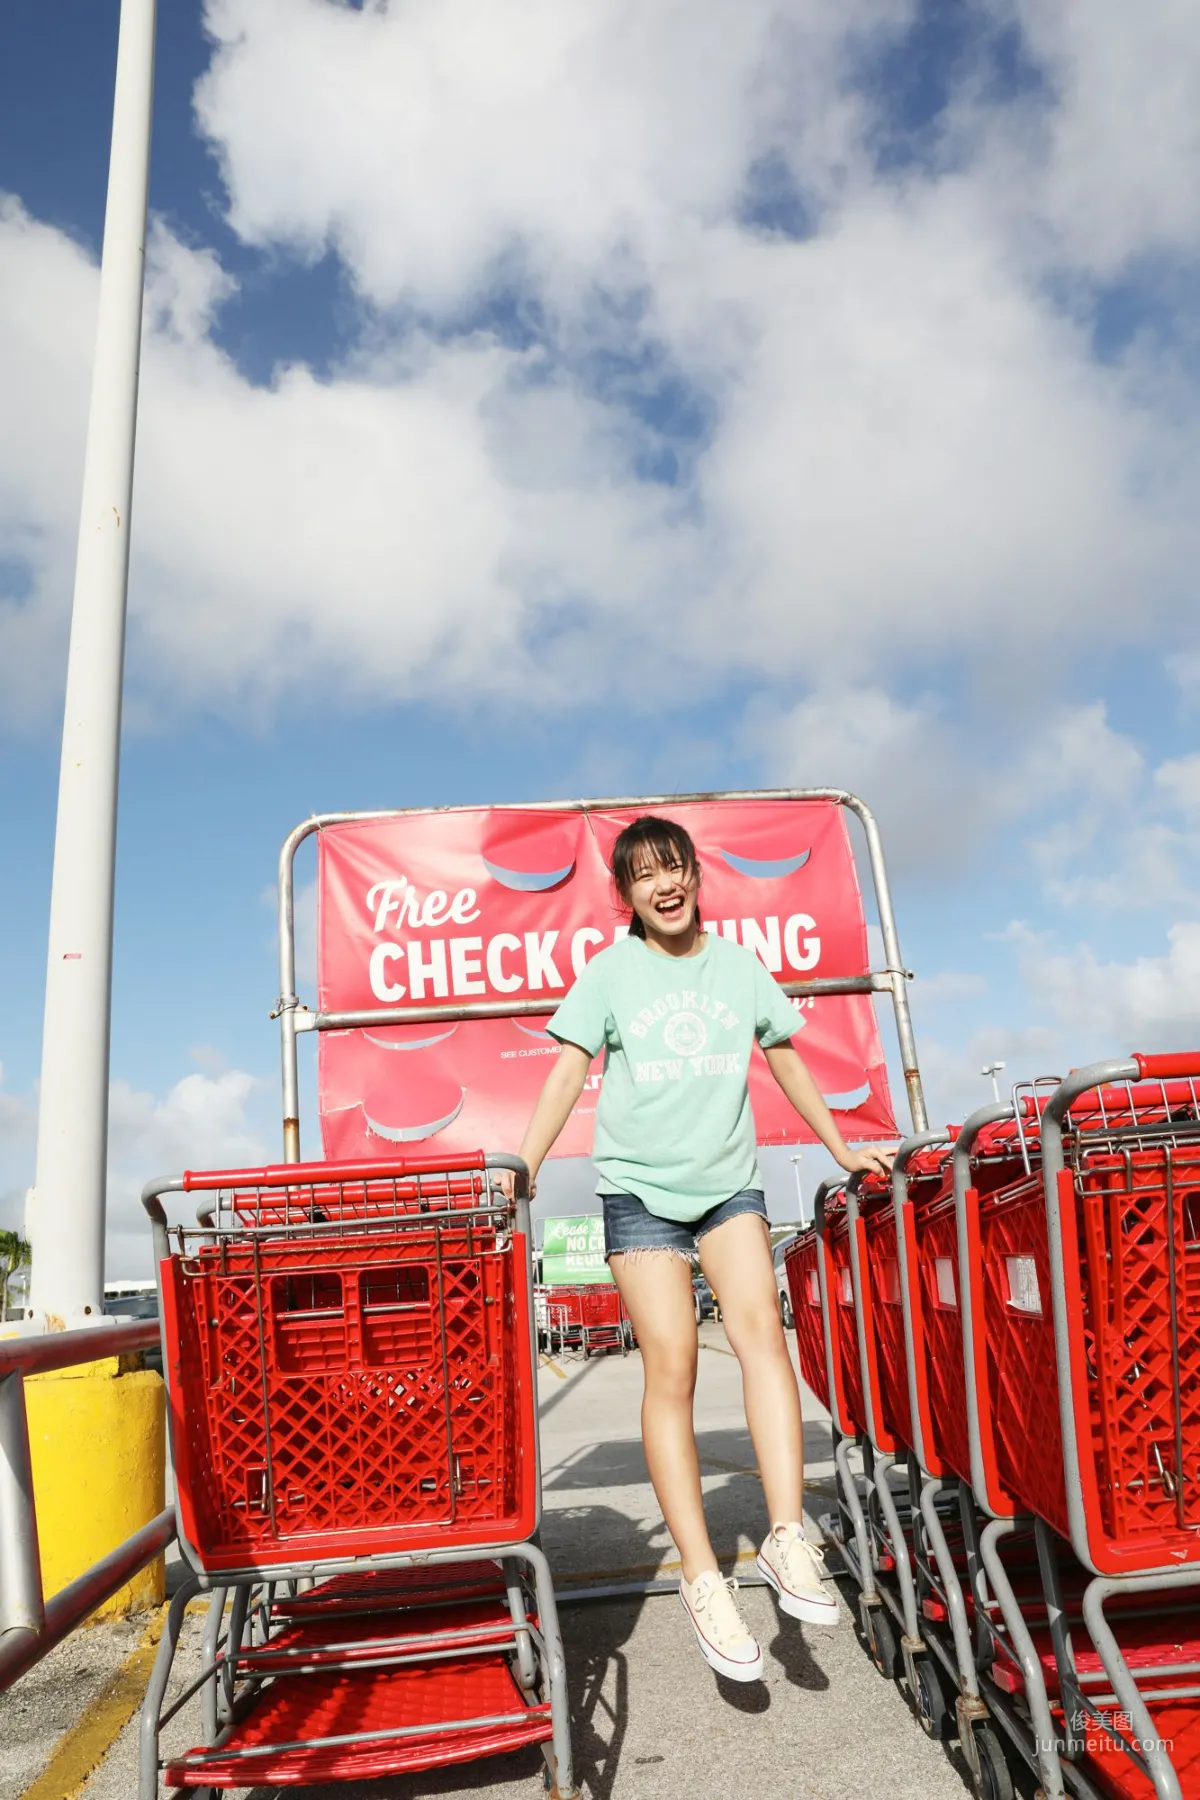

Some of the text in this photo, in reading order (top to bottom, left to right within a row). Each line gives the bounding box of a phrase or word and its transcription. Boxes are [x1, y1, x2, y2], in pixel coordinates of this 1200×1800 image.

[366, 876, 481, 933] Free
[369, 930, 565, 1003] CHECK
[628, 989, 740, 1039] BROOKLYN
[501, 1051, 517, 1059] SEE
[635, 1053, 742, 1082] NEW YORK
[567, 1236, 587, 1251] NO
